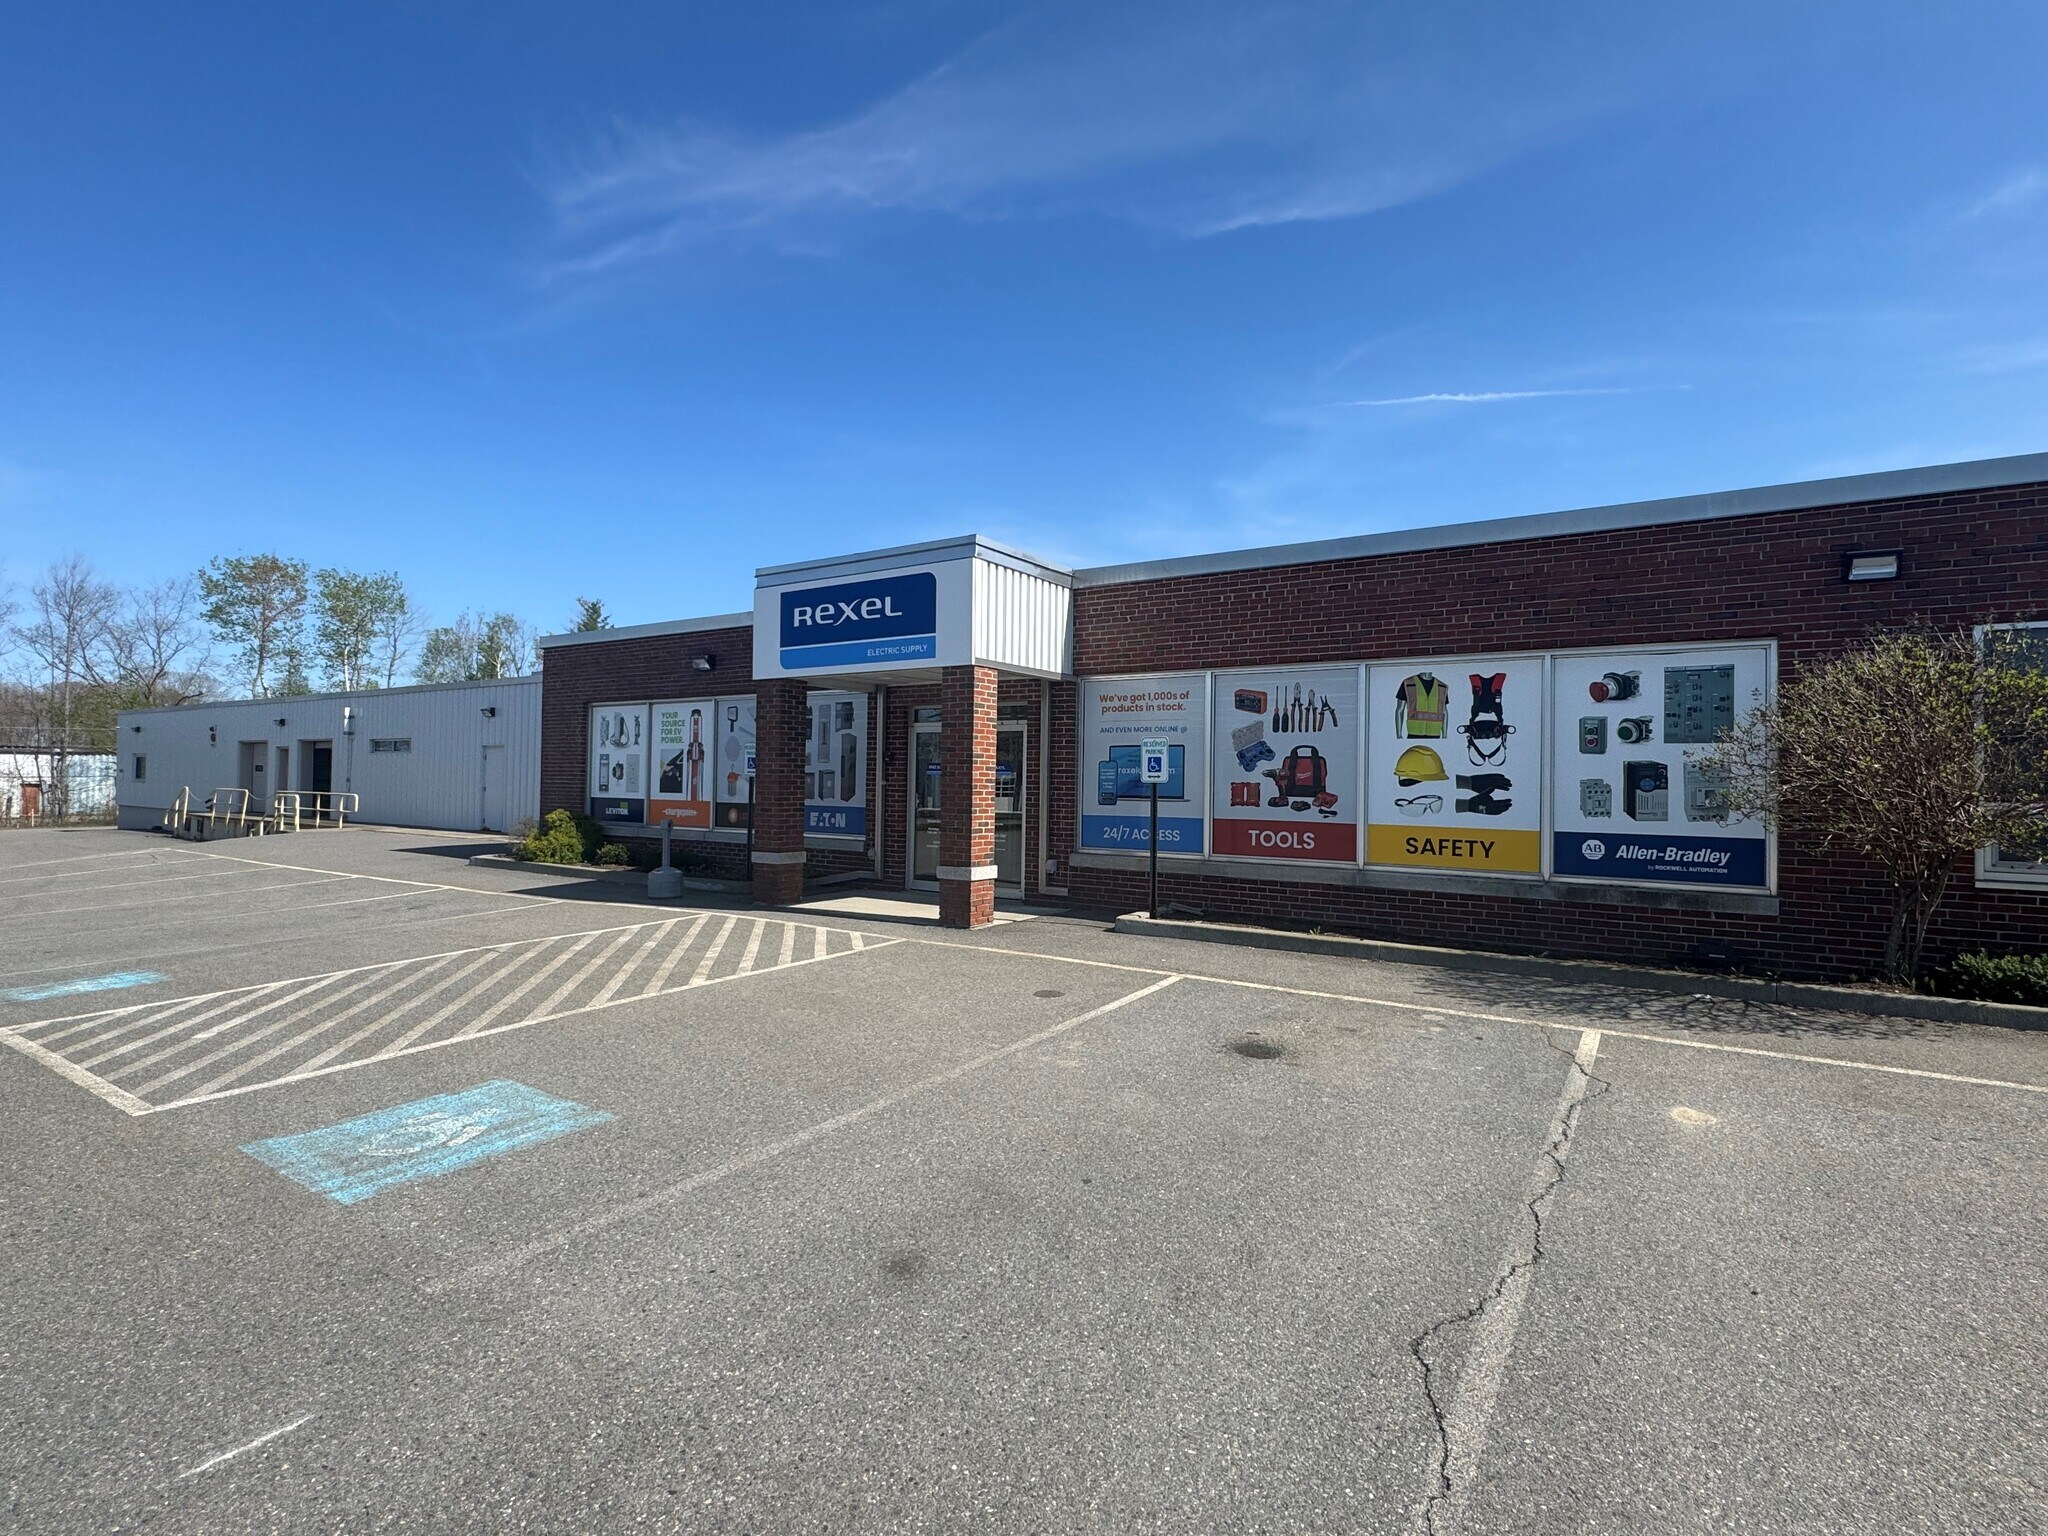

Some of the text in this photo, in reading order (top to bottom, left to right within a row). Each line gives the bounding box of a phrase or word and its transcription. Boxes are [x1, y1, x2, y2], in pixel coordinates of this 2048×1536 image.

[867, 644, 928, 657] ELECTRIC SUPPLY
[1099, 690, 1190, 704] We've got 1,000s of
[1101, 701, 1187, 716] products in stock.
[661, 711, 679, 719] YOUR
[661, 719, 686, 728] SOURCE
[661, 728, 683, 737] FOR EV
[1100, 726, 1115, 734] AND
[1115, 726, 1133, 734] EVEN
[1133, 725, 1153, 733] MORE
[1154, 725, 1179, 733] ONLINE
[661, 736, 685, 745] POWER.
[605, 807, 629, 816] LEVITON
[810, 811, 846, 828] EATON
[1103, 825, 1181, 842] 24/7 ACESS
[1248, 829, 1316, 850] TOOLS
[1405, 837, 1496, 859] SAFETY
[1584, 843, 1602, 853] AB
[1615, 844, 1731, 866] Allen-Bradley
[1655, 864, 1687, 872] ROCKWELL
[1688, 866, 1728, 874] AUTOMATION
